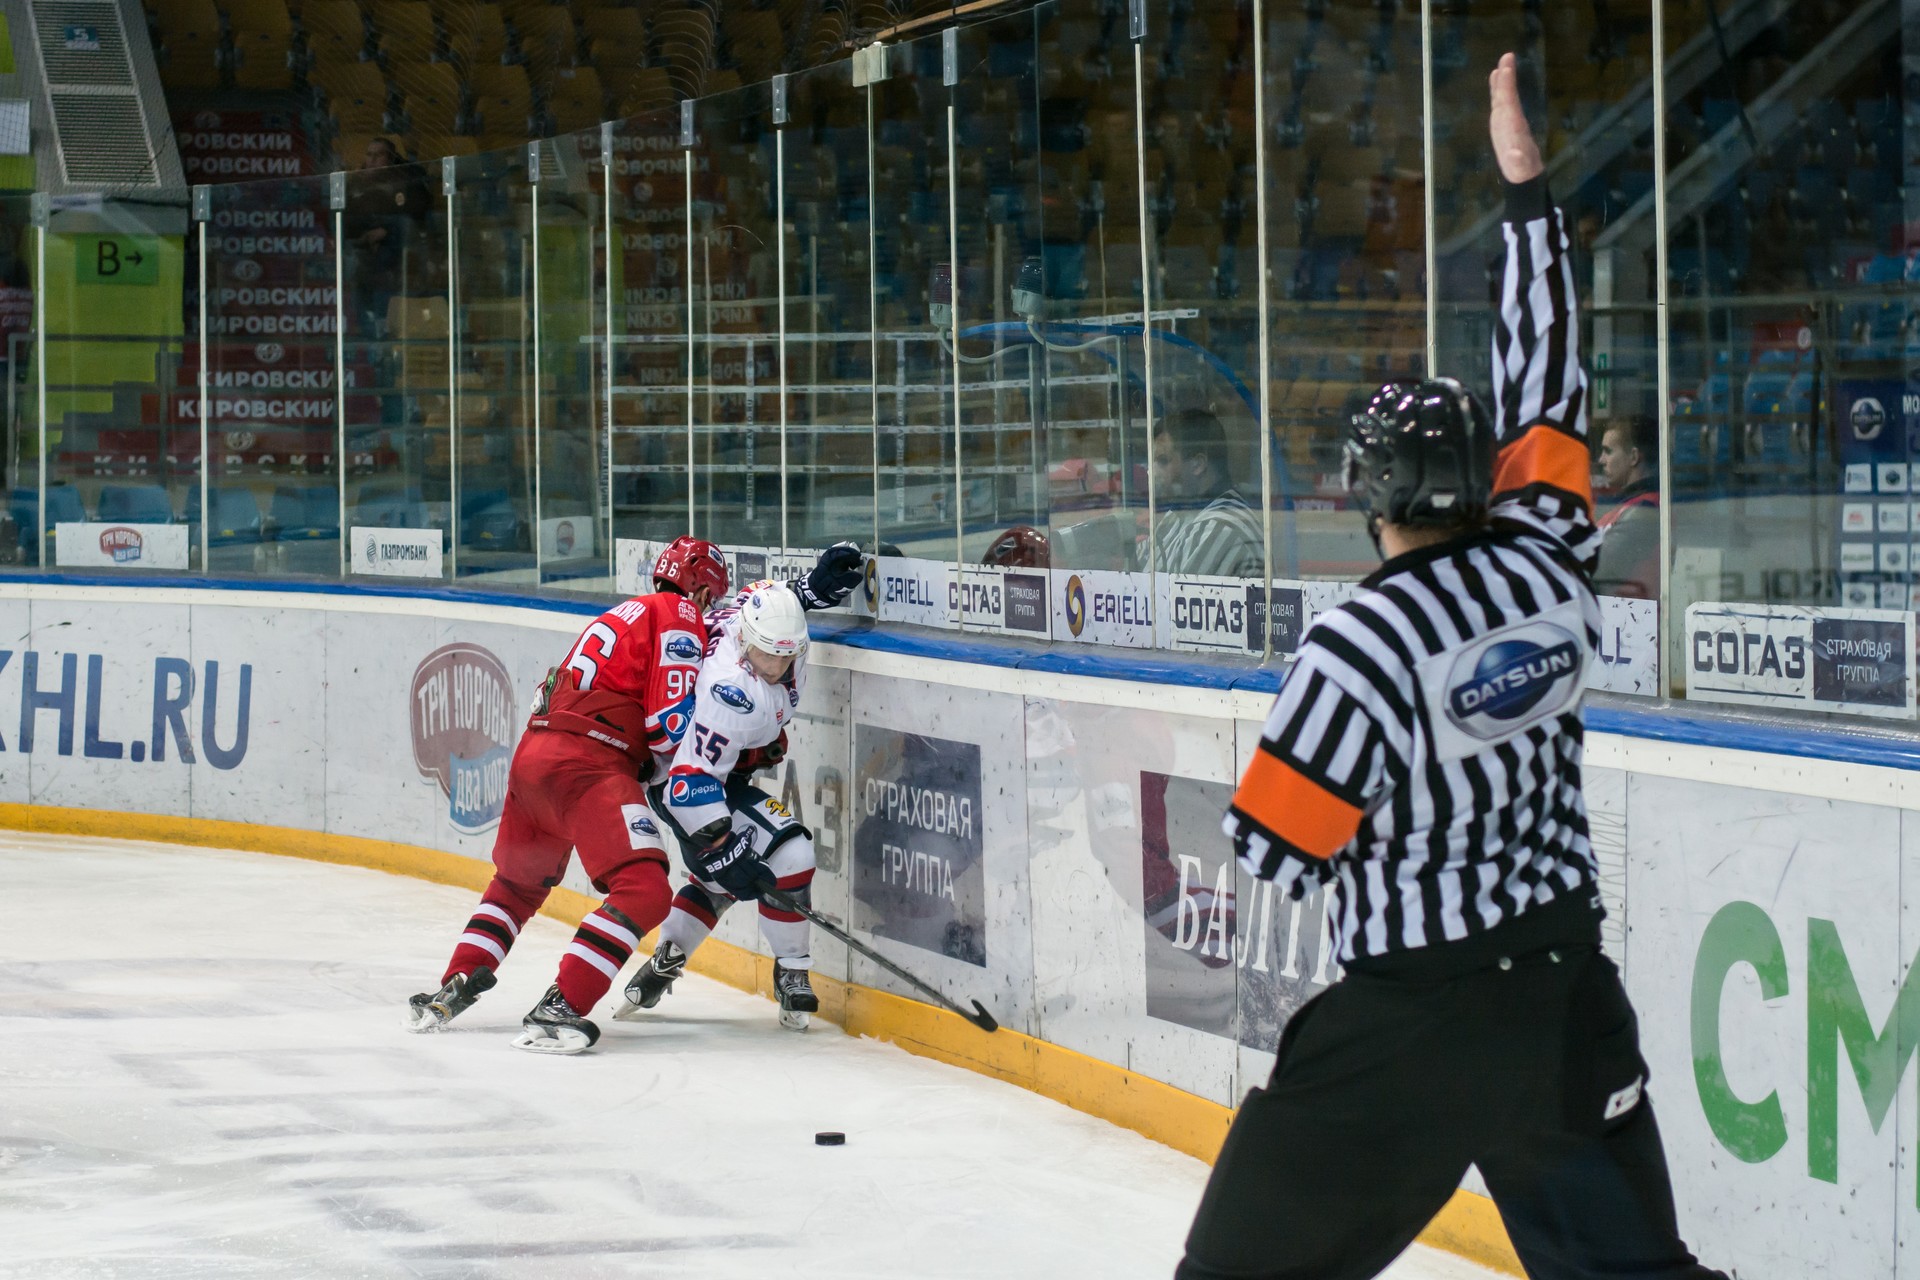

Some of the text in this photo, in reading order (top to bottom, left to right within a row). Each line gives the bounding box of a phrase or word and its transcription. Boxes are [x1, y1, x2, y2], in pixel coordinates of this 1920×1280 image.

[179, 132, 292, 150] РОВСКИЙ
[187, 155, 300, 174] РОВСКИЙ
[214, 210, 315, 229] ОВСКИЙ
[206, 235, 325, 254] РОВСКИЙ
[381, 543, 427, 561] ГАЗПРОМБАНК
[656, 558, 679, 578] 96
[886, 576, 934, 607] ERIELL
[948, 581, 1001, 615] СОГАЗ
[1094, 593, 1152, 627] ERIELL
[1174, 596, 1243, 634] СОГАЗ
[1254, 601, 1295, 618] СТРХОВАЯ
[564, 621, 617, 691] 6
[668, 644, 701, 655] DATSUN
[1693, 629, 1806, 680] СОГАЗ
[1826, 637, 1892, 660] СТРАХОВАЯ
[1459, 650, 1572, 711] DATSUN
[1836, 662, 1880, 684] ГРУППА
[0, 650, 253, 771] HL.RU
[418, 663, 512, 749] ТРИ КОРОВЫ
[715, 685, 752, 710] DATSUN
[691, 783, 717, 798] pepsi
[866, 776, 973, 840] СТРАХОВАЯ
[705, 836, 749, 874] BAUER
[881, 843, 955, 903] ГРУППА
